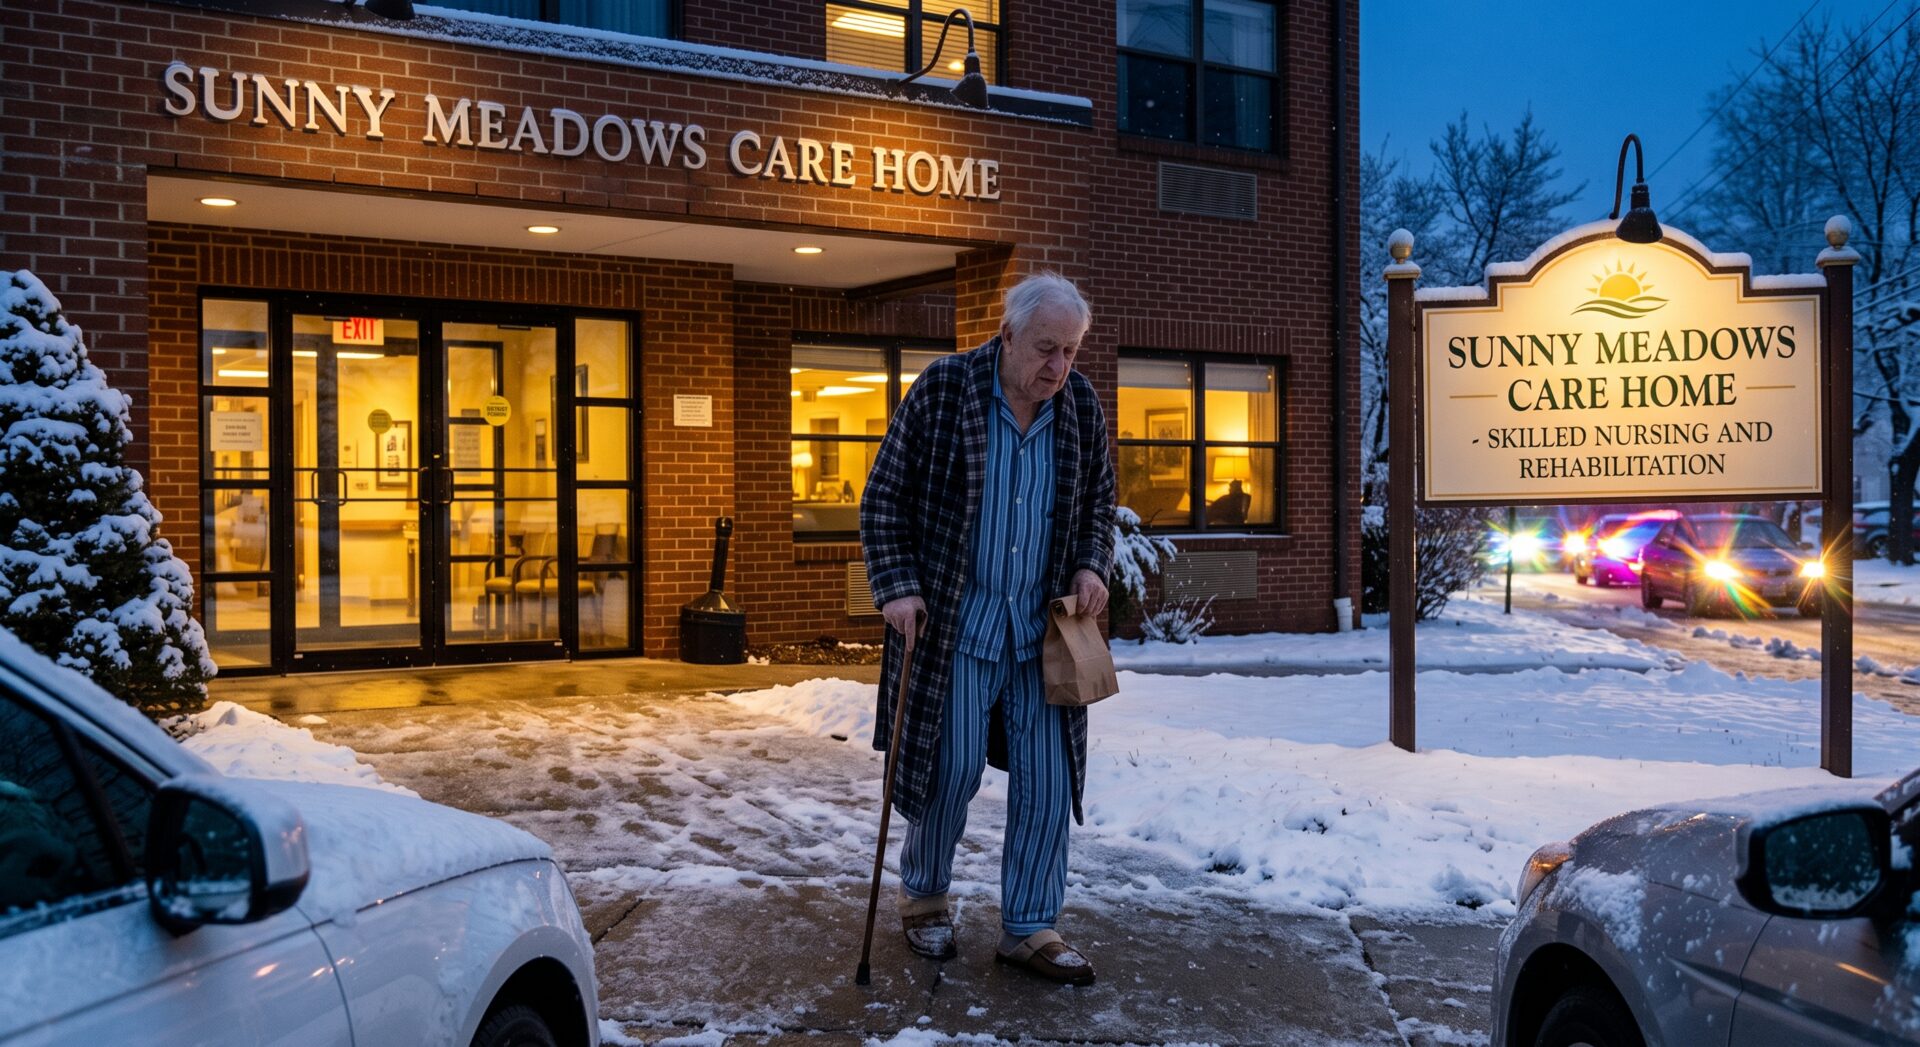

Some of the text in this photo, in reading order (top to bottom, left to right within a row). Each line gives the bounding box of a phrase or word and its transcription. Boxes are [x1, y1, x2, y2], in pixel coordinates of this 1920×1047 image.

[164, 60, 1001, 201] SUNNY MEADOWS CARE HOME
[342, 317, 376, 340] EXIT
[1448, 325, 1796, 369] SUNNY MEADOWS
[1507, 372, 1738, 412] CARE HOME
[1487, 425, 1587, 449] SKILLED
[1594, 422, 1709, 447] NURSING
[1717, 421, 1773, 443] AND
[1519, 452, 1726, 479] REHABILITATION
